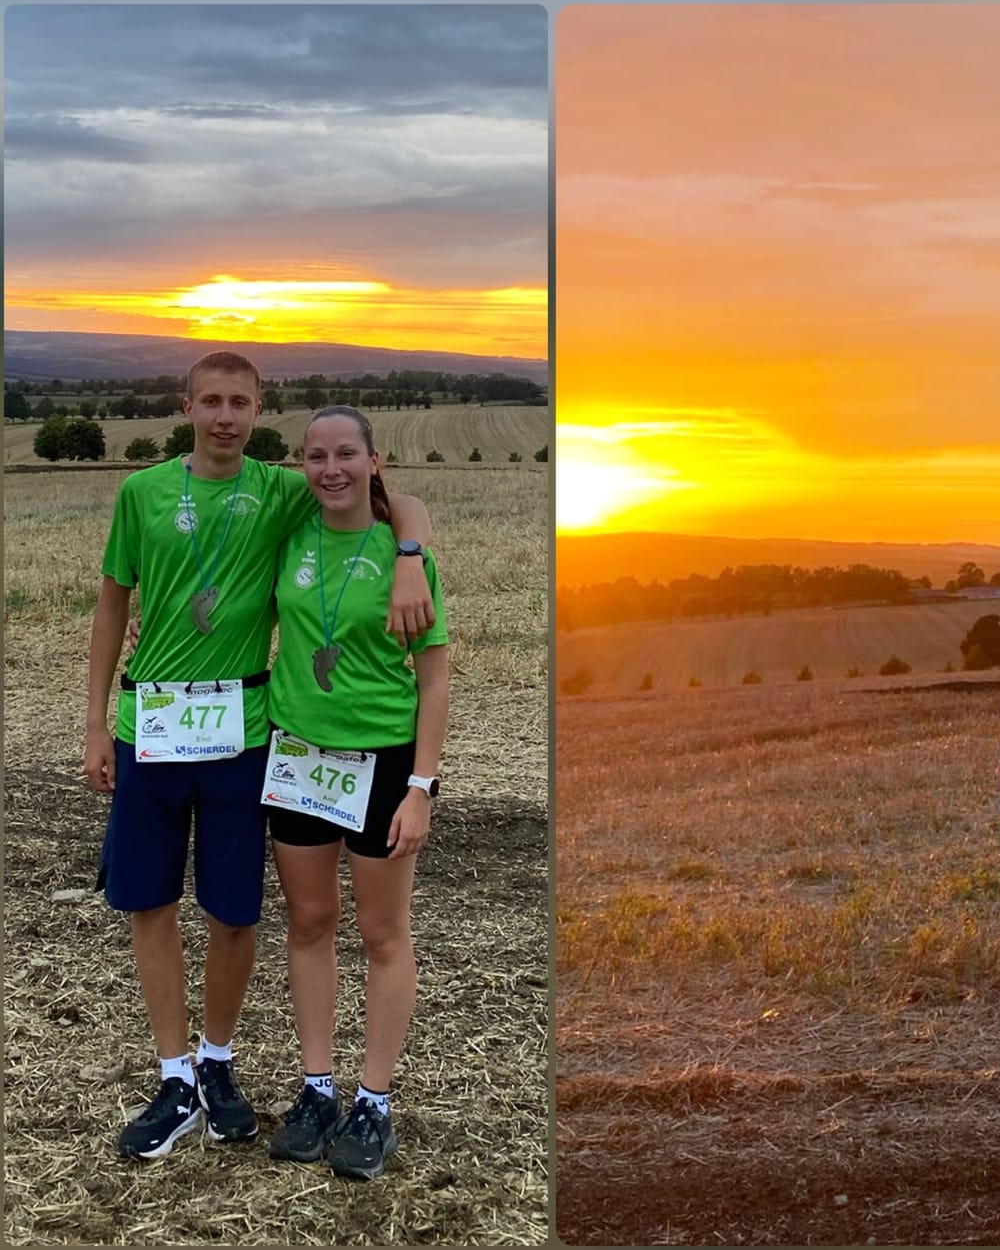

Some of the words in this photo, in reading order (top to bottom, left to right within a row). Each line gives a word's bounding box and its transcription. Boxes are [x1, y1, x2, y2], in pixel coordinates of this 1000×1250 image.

[179, 705, 227, 730] 477
[186, 745, 238, 755] SCHERDEL
[309, 764, 357, 795] 476
[312, 801, 357, 824] SCHERDEL
